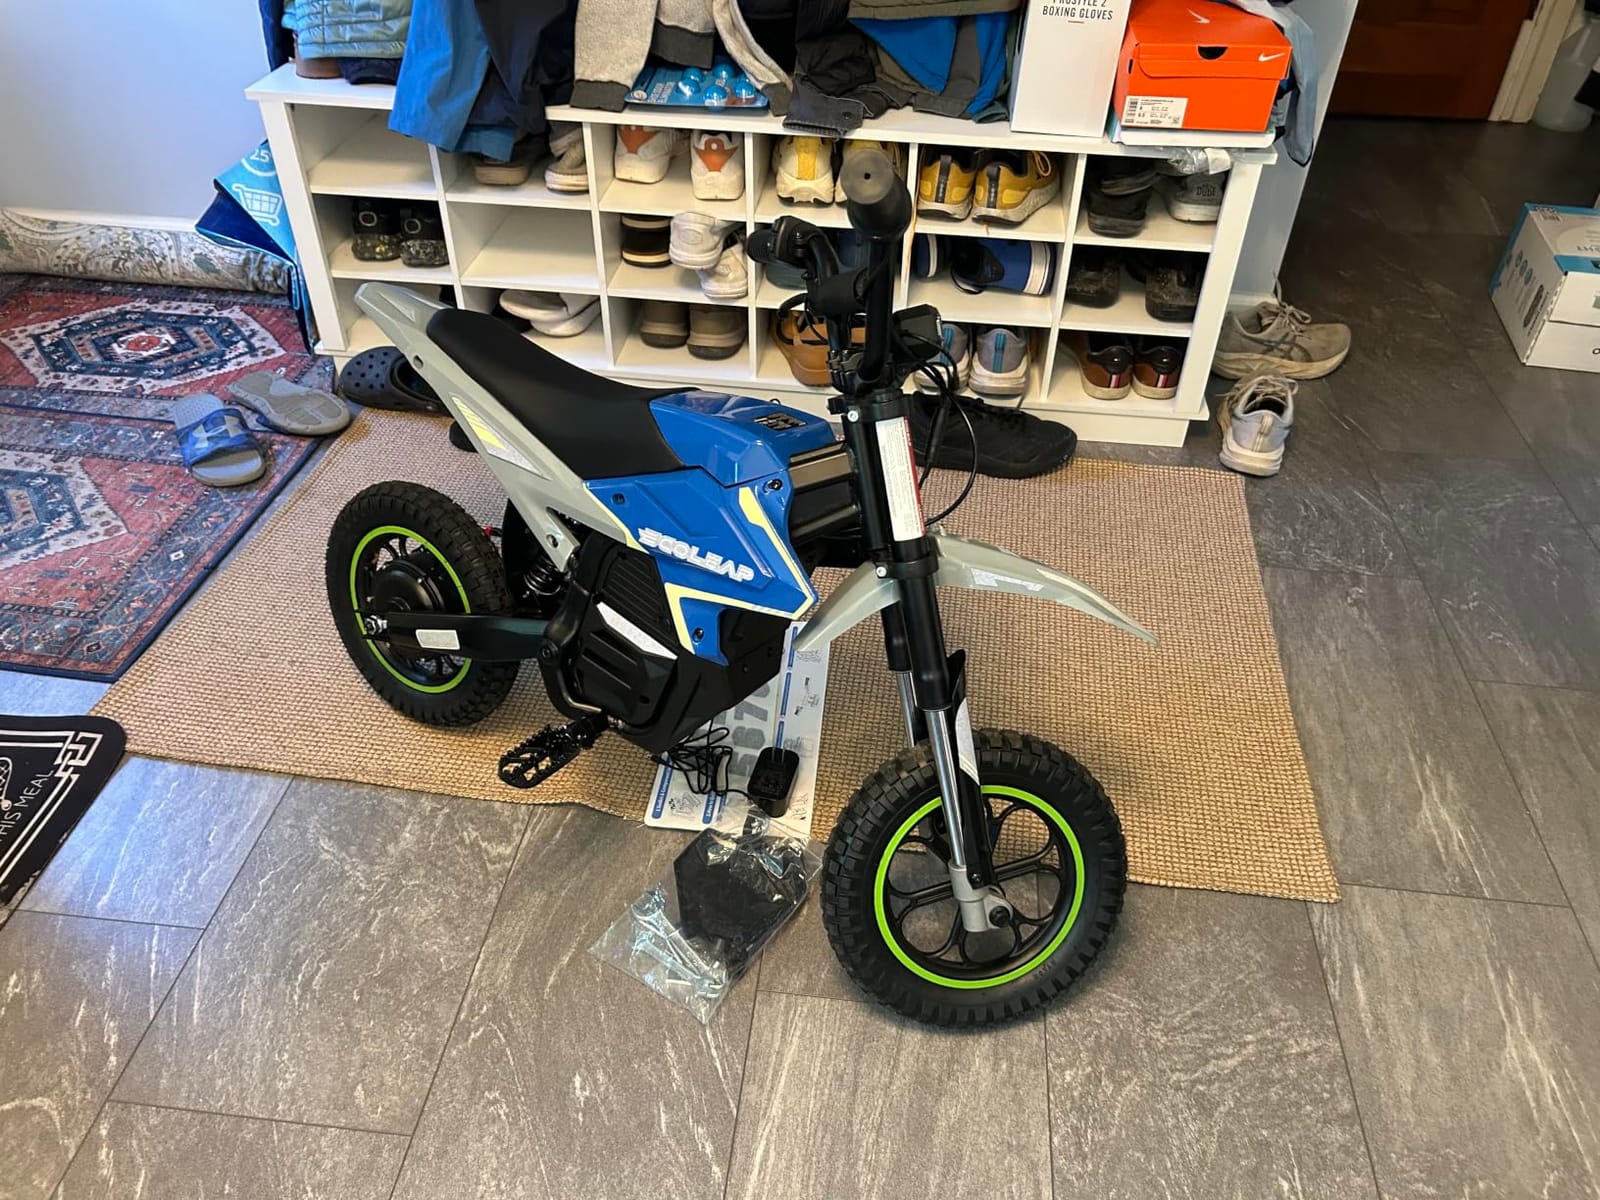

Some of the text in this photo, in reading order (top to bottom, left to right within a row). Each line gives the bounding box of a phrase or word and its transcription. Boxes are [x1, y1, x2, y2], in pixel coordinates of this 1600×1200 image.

[1042, 5, 1114, 20] BOXING GLOVES
[637, 526, 755, 582] ECOLEAP
[0, 770, 54, 842] HIS MEAL
